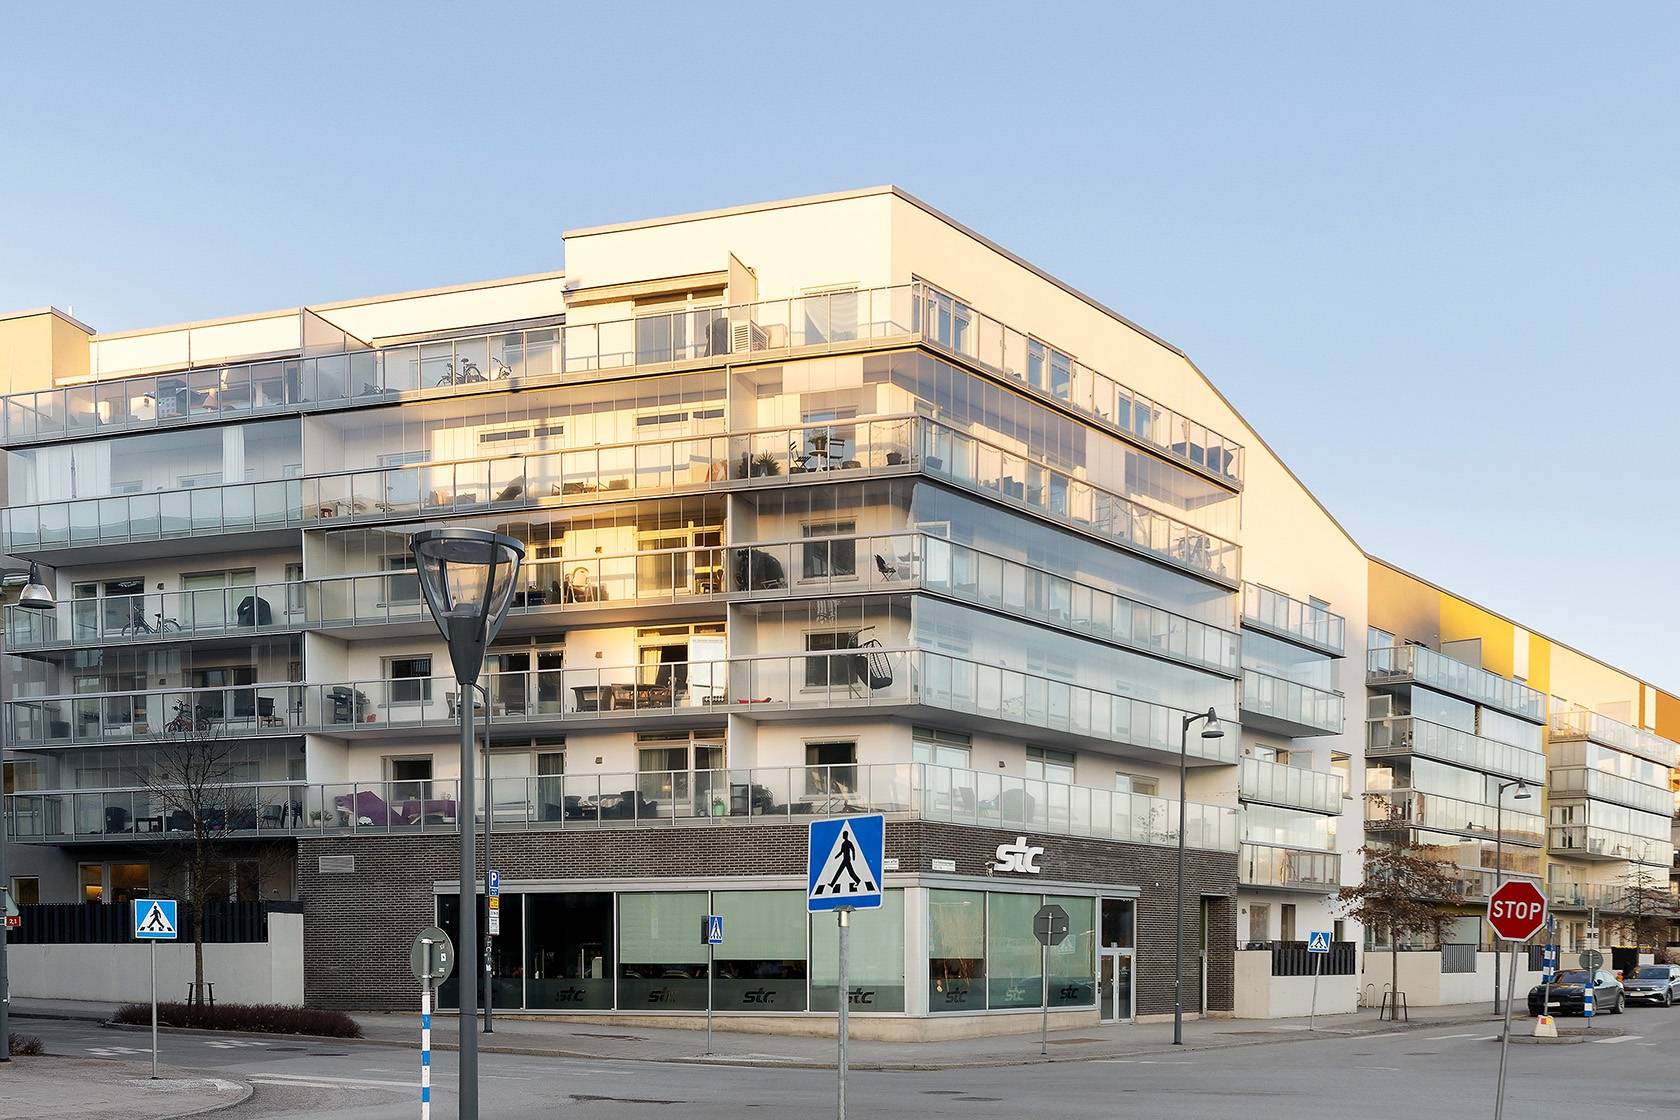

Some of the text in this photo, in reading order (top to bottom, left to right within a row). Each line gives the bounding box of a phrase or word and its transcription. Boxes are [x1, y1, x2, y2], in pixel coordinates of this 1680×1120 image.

[994, 836, 1044, 873] stc
[491, 873, 497, 885] P
[1492, 900, 1542, 920] STOP
[945, 987, 968, 1003] stc
[1060, 985, 1078, 999] stc
